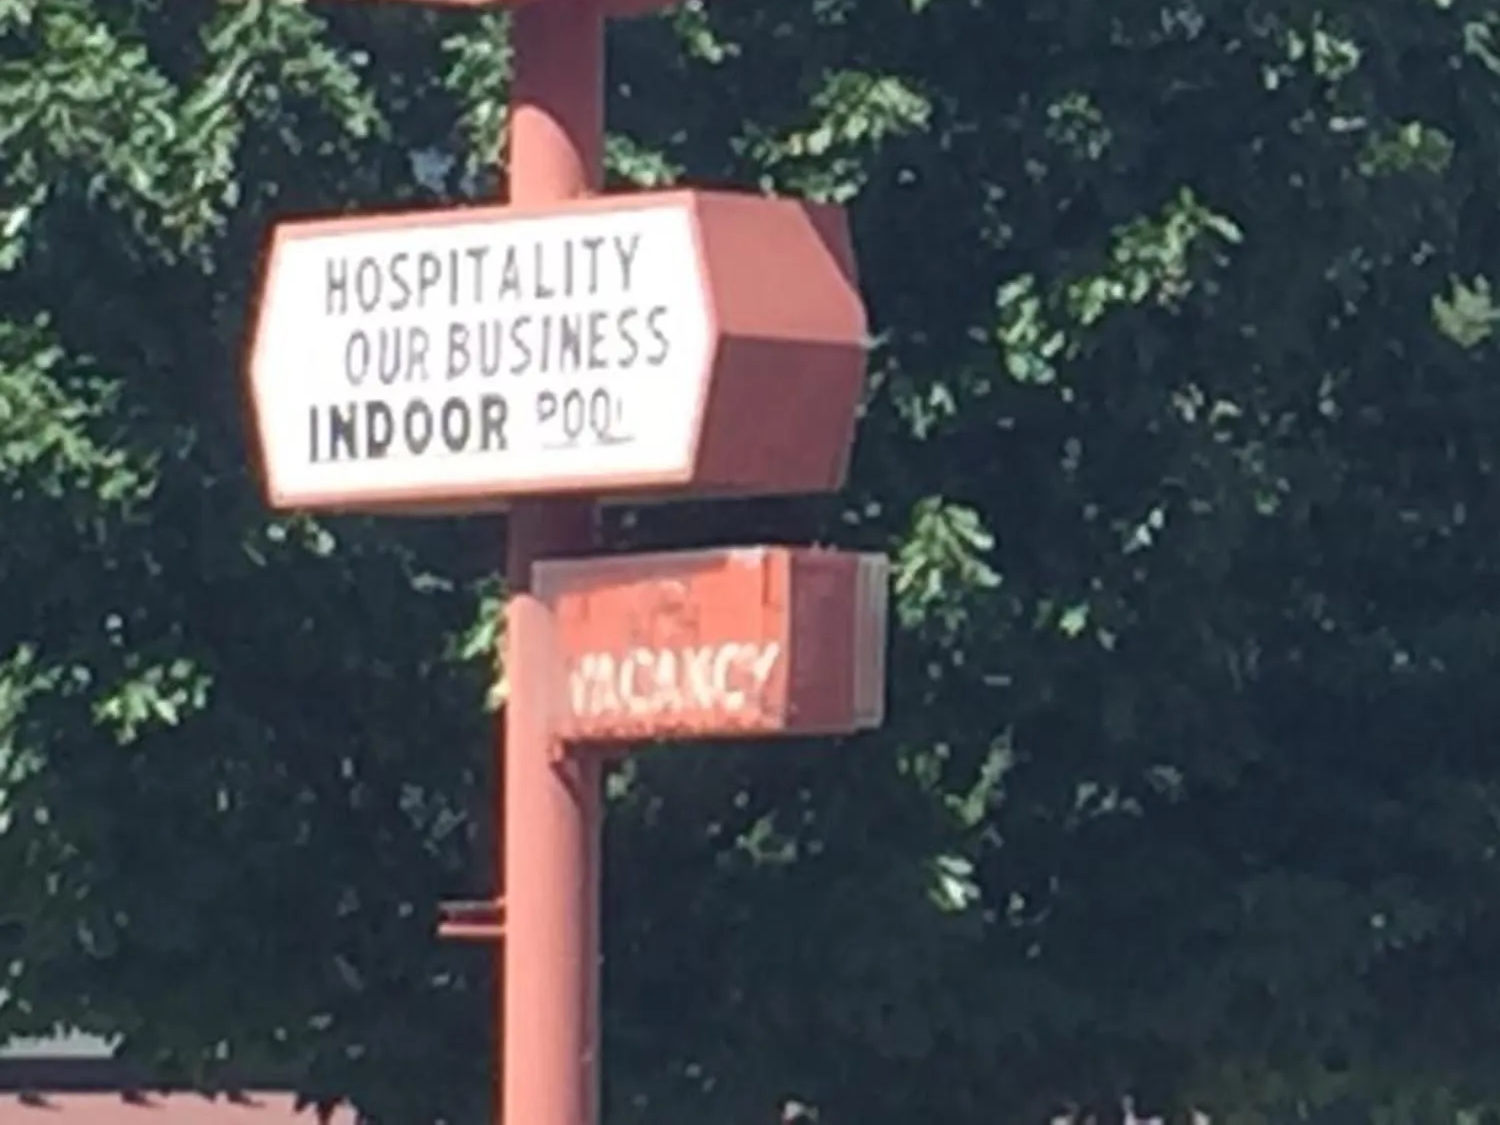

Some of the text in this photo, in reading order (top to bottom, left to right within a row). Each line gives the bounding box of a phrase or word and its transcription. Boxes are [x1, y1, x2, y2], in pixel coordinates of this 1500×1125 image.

[324, 234, 643, 316] HOSPITALITY
[345, 306, 671, 386] OUR BUSINESS
[309, 393, 508, 463] INDOOR
[569, 641, 782, 718] VACANCY
